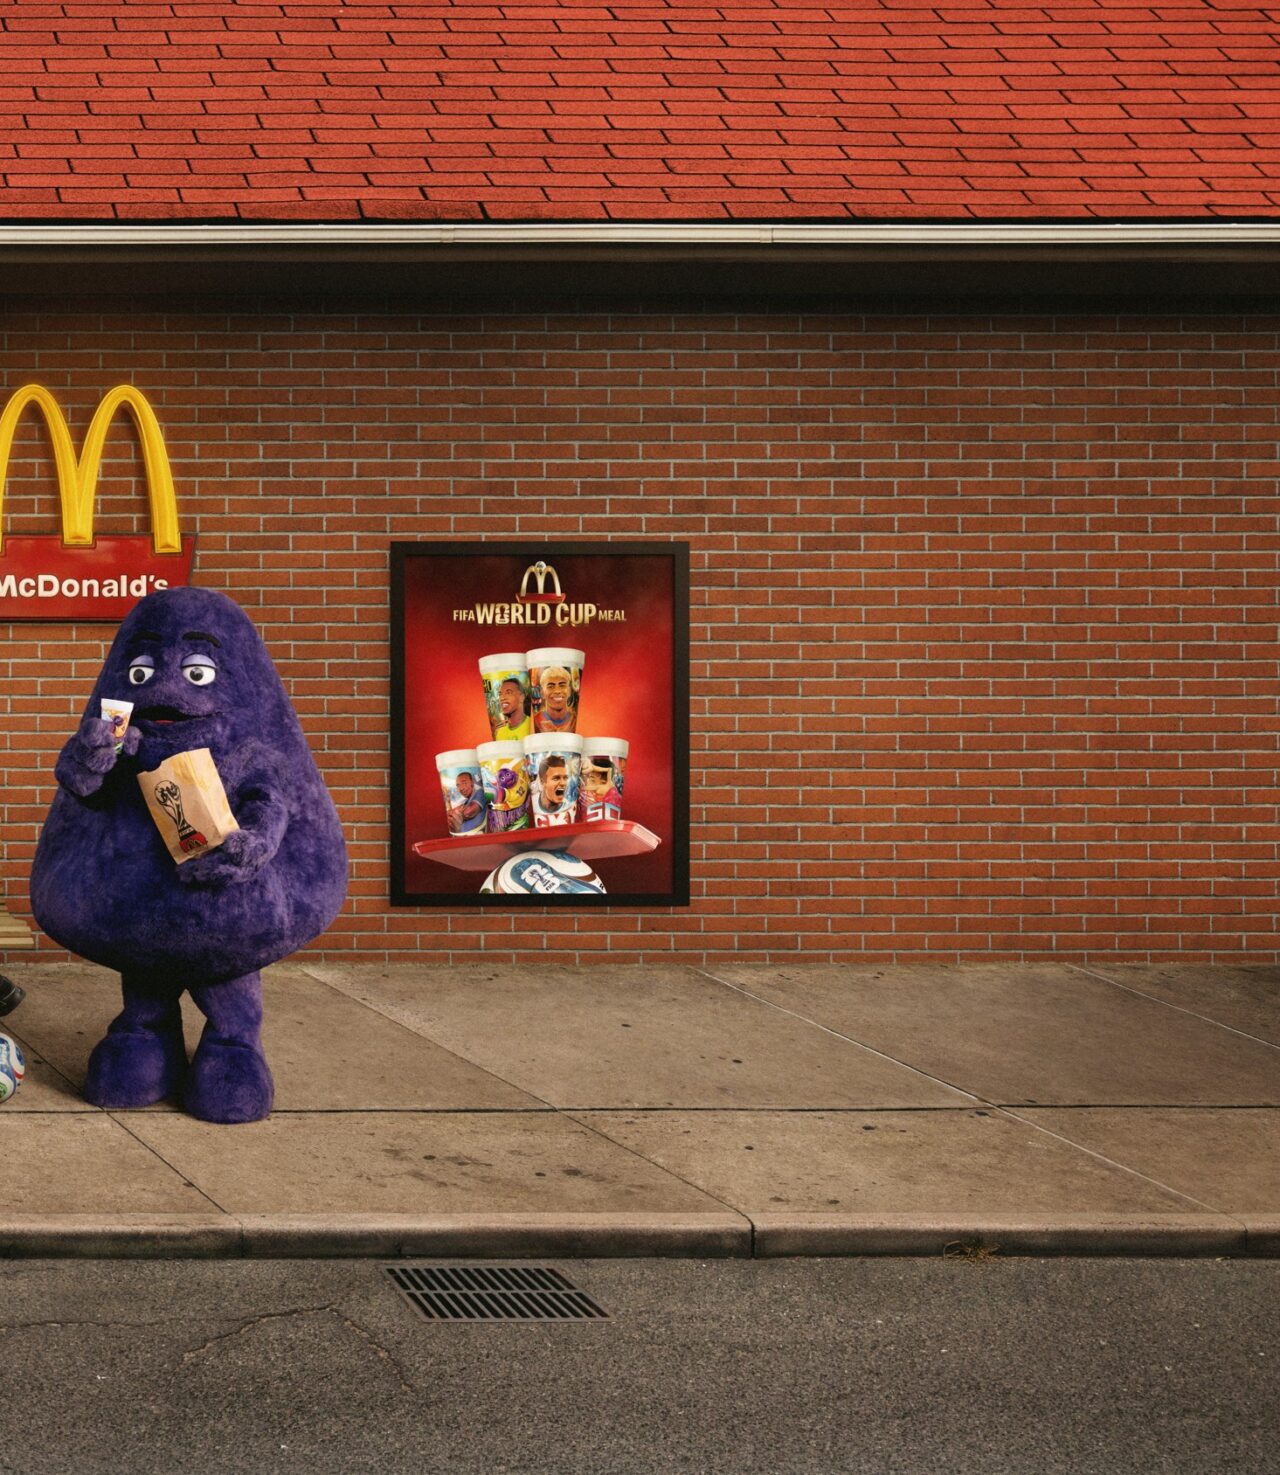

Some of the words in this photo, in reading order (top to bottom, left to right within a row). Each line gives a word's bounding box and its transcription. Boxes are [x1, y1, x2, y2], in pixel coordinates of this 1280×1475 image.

[453, 609, 475, 621] FIFA
[475, 603, 551, 625] WORLD
[555, 603, 597, 626] CUP
[598, 610, 627, 621] MEAL
